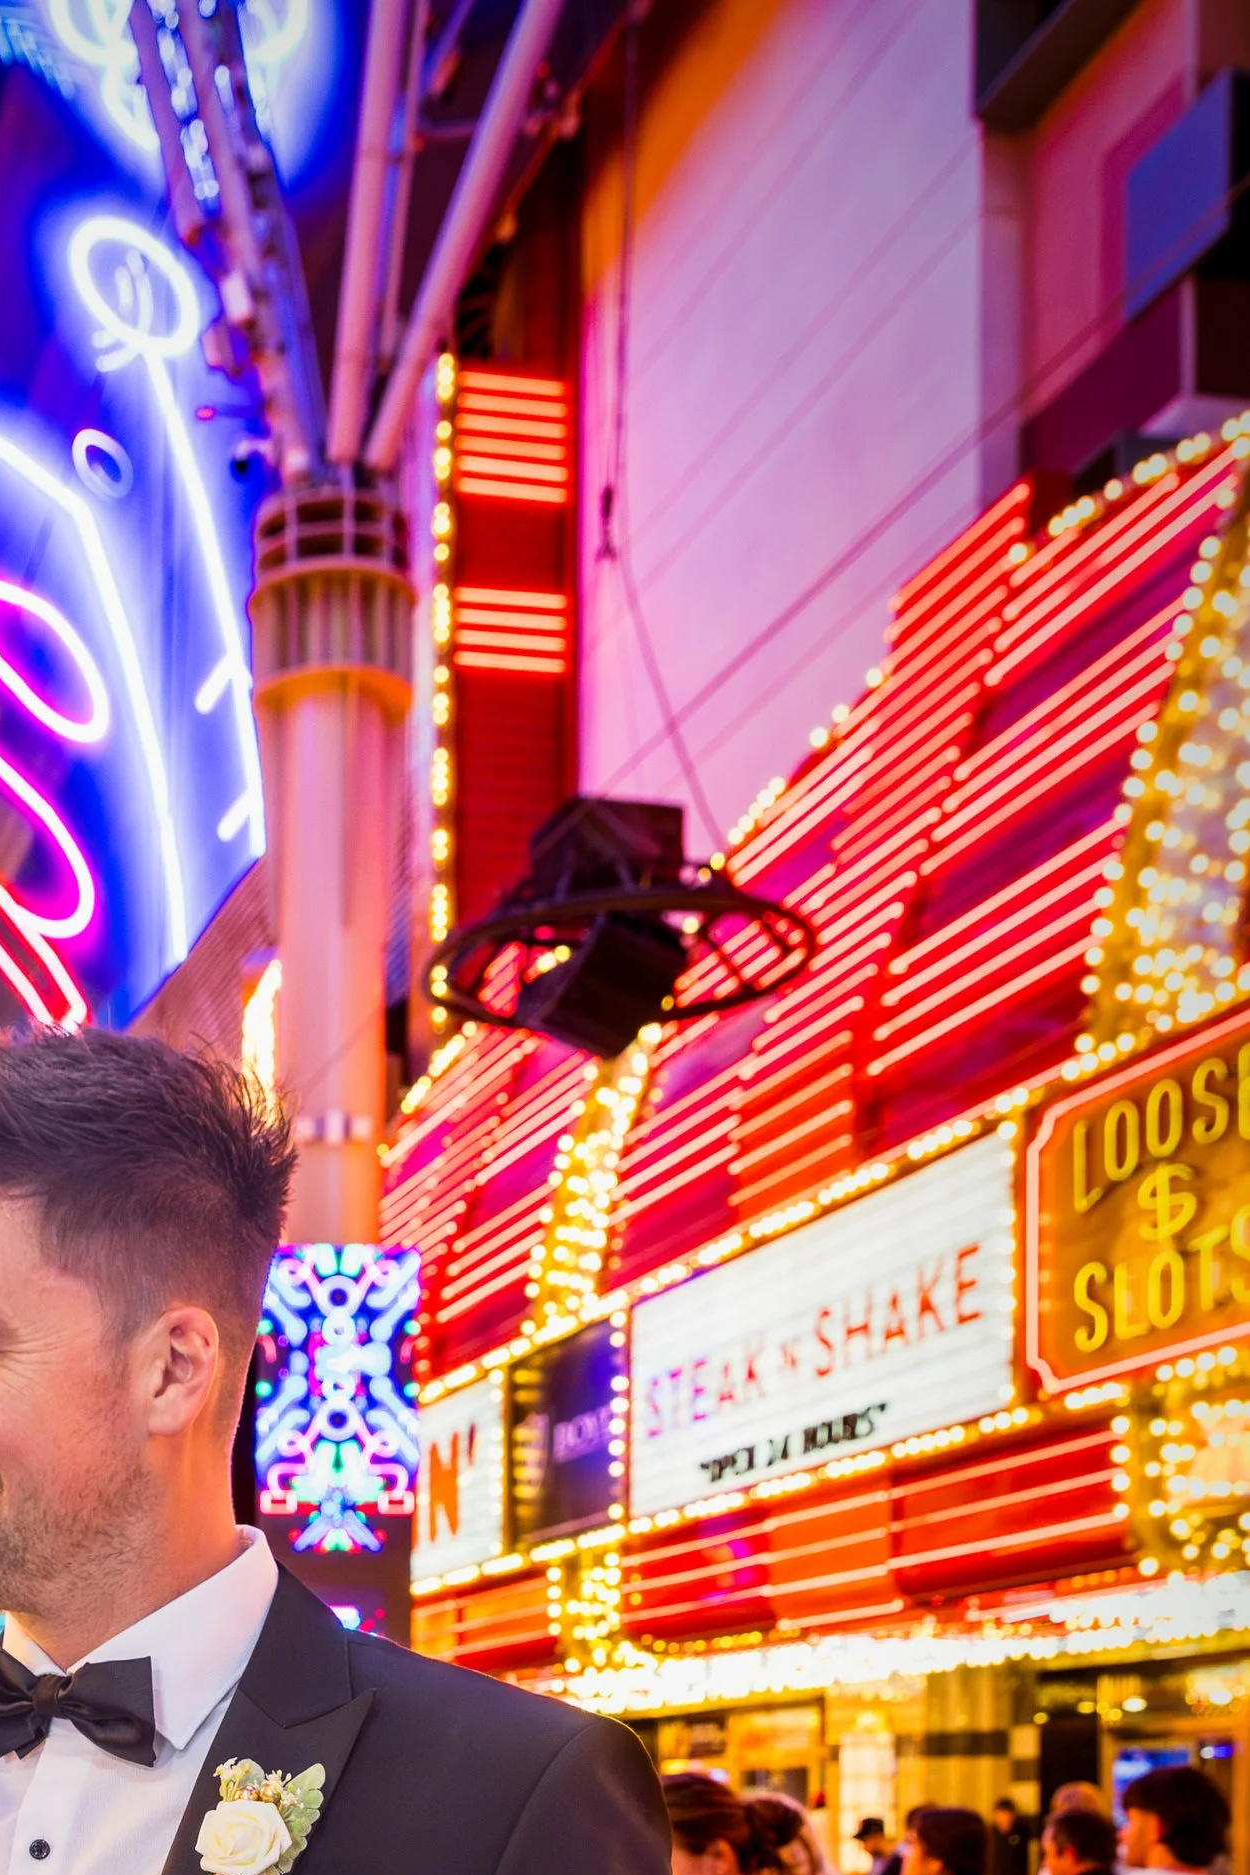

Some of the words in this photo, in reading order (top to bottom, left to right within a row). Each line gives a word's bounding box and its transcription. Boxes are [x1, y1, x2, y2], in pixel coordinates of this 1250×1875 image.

[647, 1331, 766, 1437] STEAK
[813, 1241, 984, 1378] SHAKE
[1073, 1203, 1250, 1352] SLOTS
